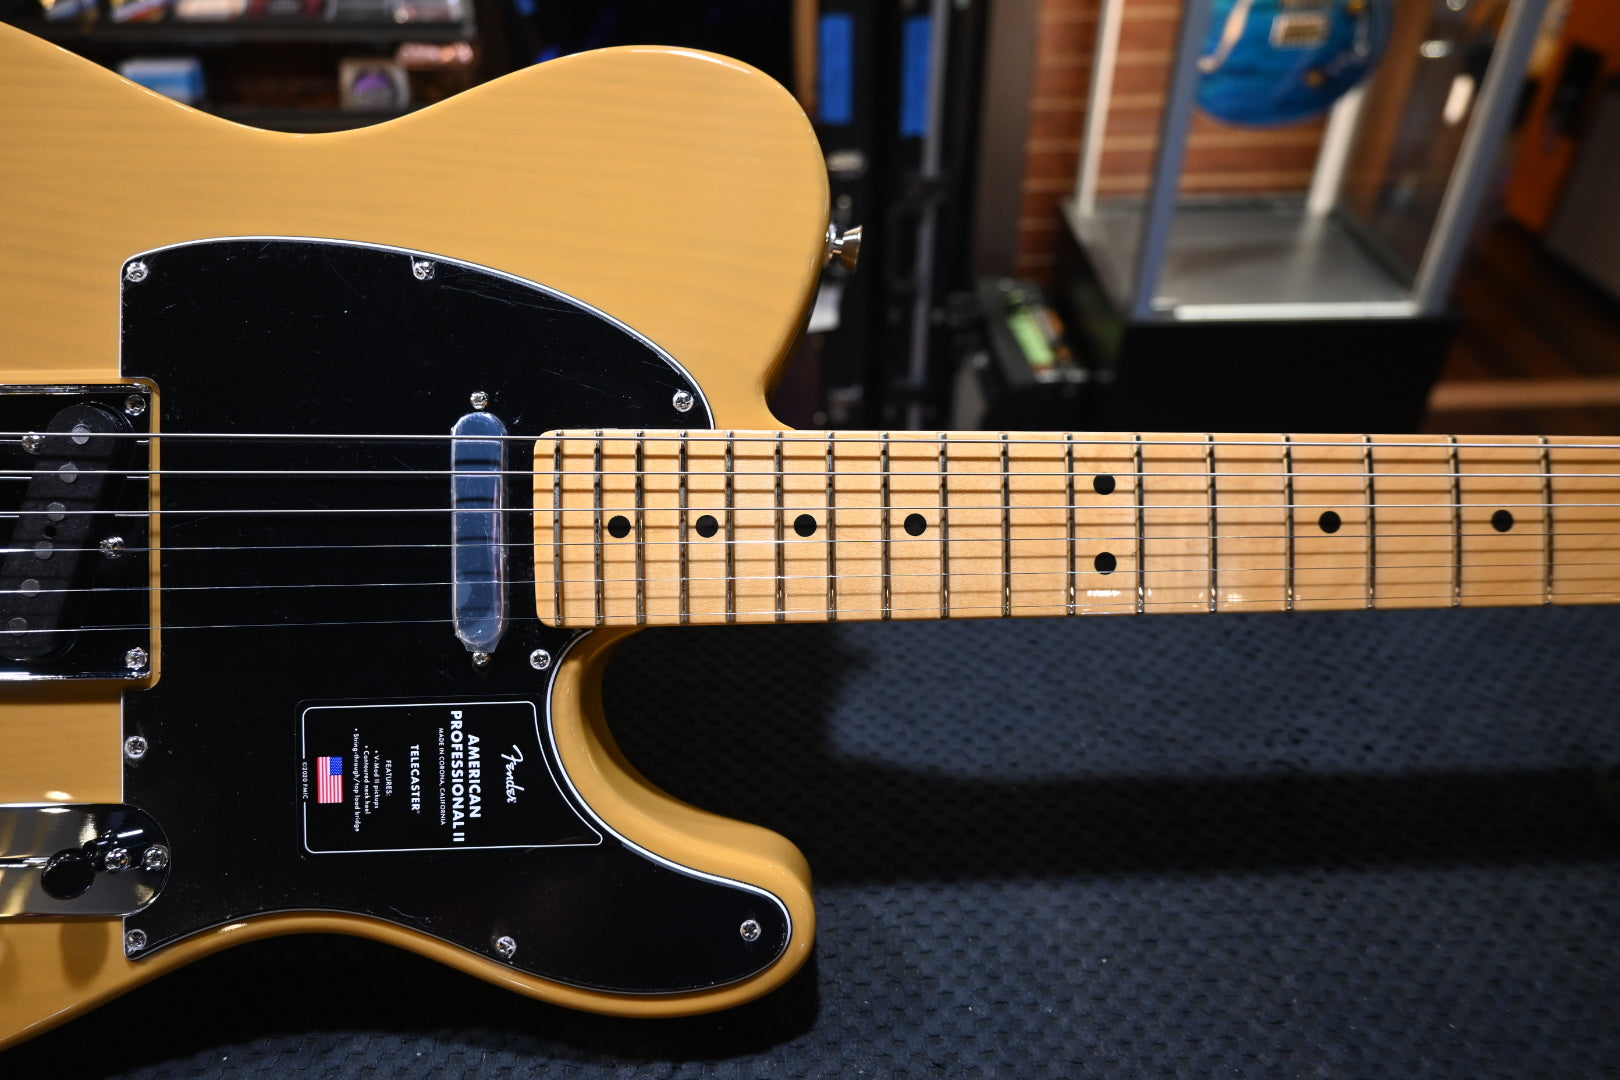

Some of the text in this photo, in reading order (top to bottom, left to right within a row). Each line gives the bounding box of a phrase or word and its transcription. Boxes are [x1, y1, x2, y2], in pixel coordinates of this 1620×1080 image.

[439, 747, 445, 755] IN
[450, 710, 465, 842] PROFESSIONAL II
[468, 734, 481, 818] AMERICAN
[372, 785, 381, 809] pickups
[353, 811, 361, 832] bridge
